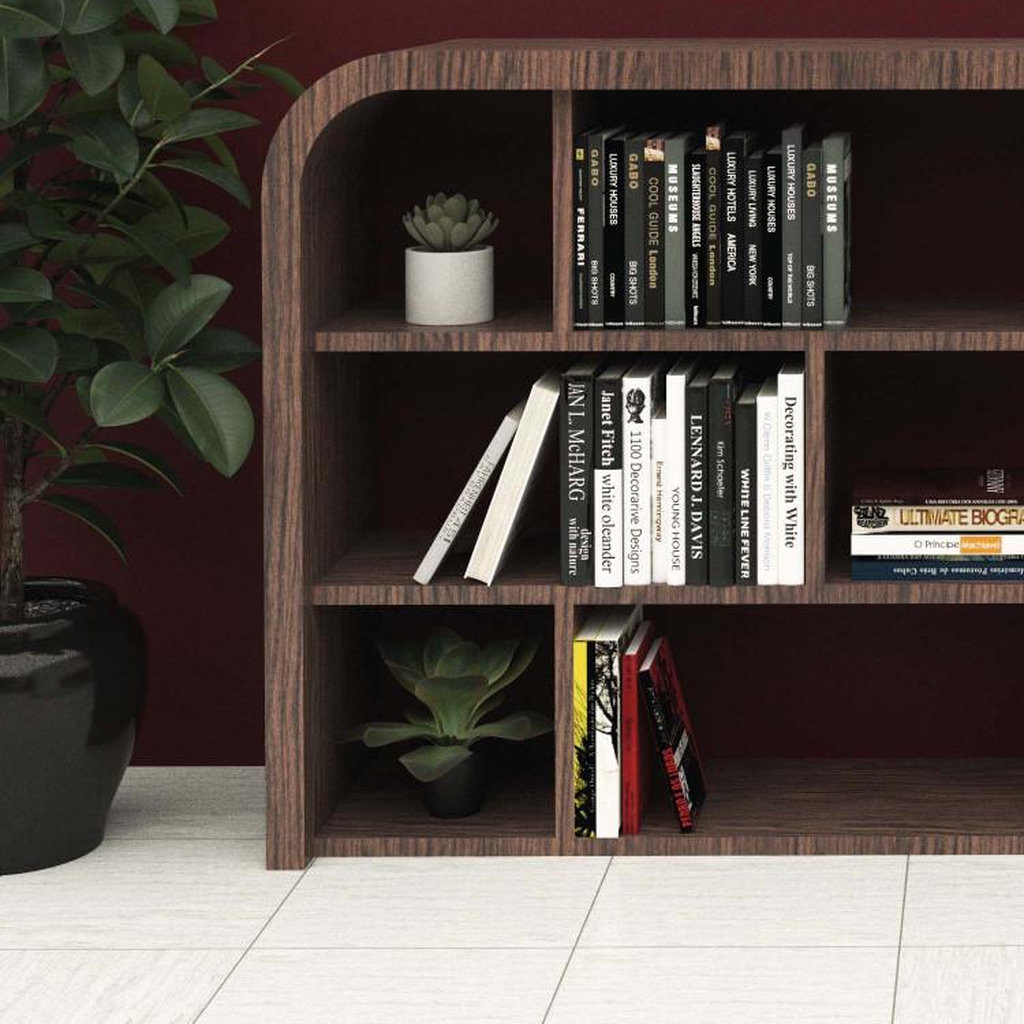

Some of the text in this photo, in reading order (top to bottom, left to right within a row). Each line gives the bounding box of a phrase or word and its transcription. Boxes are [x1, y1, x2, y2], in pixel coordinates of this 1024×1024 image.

[590, 149, 599, 186] GABO
[609, 153, 618, 225] LUXURY HOUSES
[628, 153, 639, 190] GABO
[691, 163, 701, 222] SLAUGHTERHOUSE
[726, 152, 736, 222] LUXURY HOTELS
[787, 144, 796, 220] LUXURY HOUSES
[806, 163, 816, 198] GABO
[668, 164, 678, 233] MUSEUMS
[709, 167, 717, 286] COOL GUIDE London
[748, 170, 757, 227] LUXURY LIVING
[767, 166, 776, 233] LUXURY HOUSES
[826, 164, 837, 233] MUSEUMS
[577, 208, 585, 266] FERRARI
[648, 177, 659, 288] COOL GUIDE London
[691, 223, 701, 247] ANGELS
[726, 233, 736, 272] AMERICA
[590, 260, 599, 305] BIG SHOTS
[628, 261, 638, 305] BIG SHOTS
[748, 244, 757, 286] NEW YORK
[806, 265, 816, 307] BIG SHOTS
[567, 412, 585, 425] L.
[601, 390, 615, 466] Janet Fitch
[630, 431, 642, 459] 1100
[567, 429, 585, 502] McHARG
[716, 440, 725, 457] Kim
[782, 396, 798, 549] Decorating with White
[690, 414, 703, 560] LENNARD J. DAVIS
[579, 528, 592, 560] design
[601, 474, 615, 573] white oleander
[671, 487, 680, 571] YOUNG HOUSE
[740, 468, 750, 579] WHITE LINE FEVER
[899, 508, 969, 526] ULTIMATE
[914, 540, 922, 549] O
[568, 517, 578, 576] with nature
[628, 528, 642, 574] Designs
[939, 567, 949, 576] de
